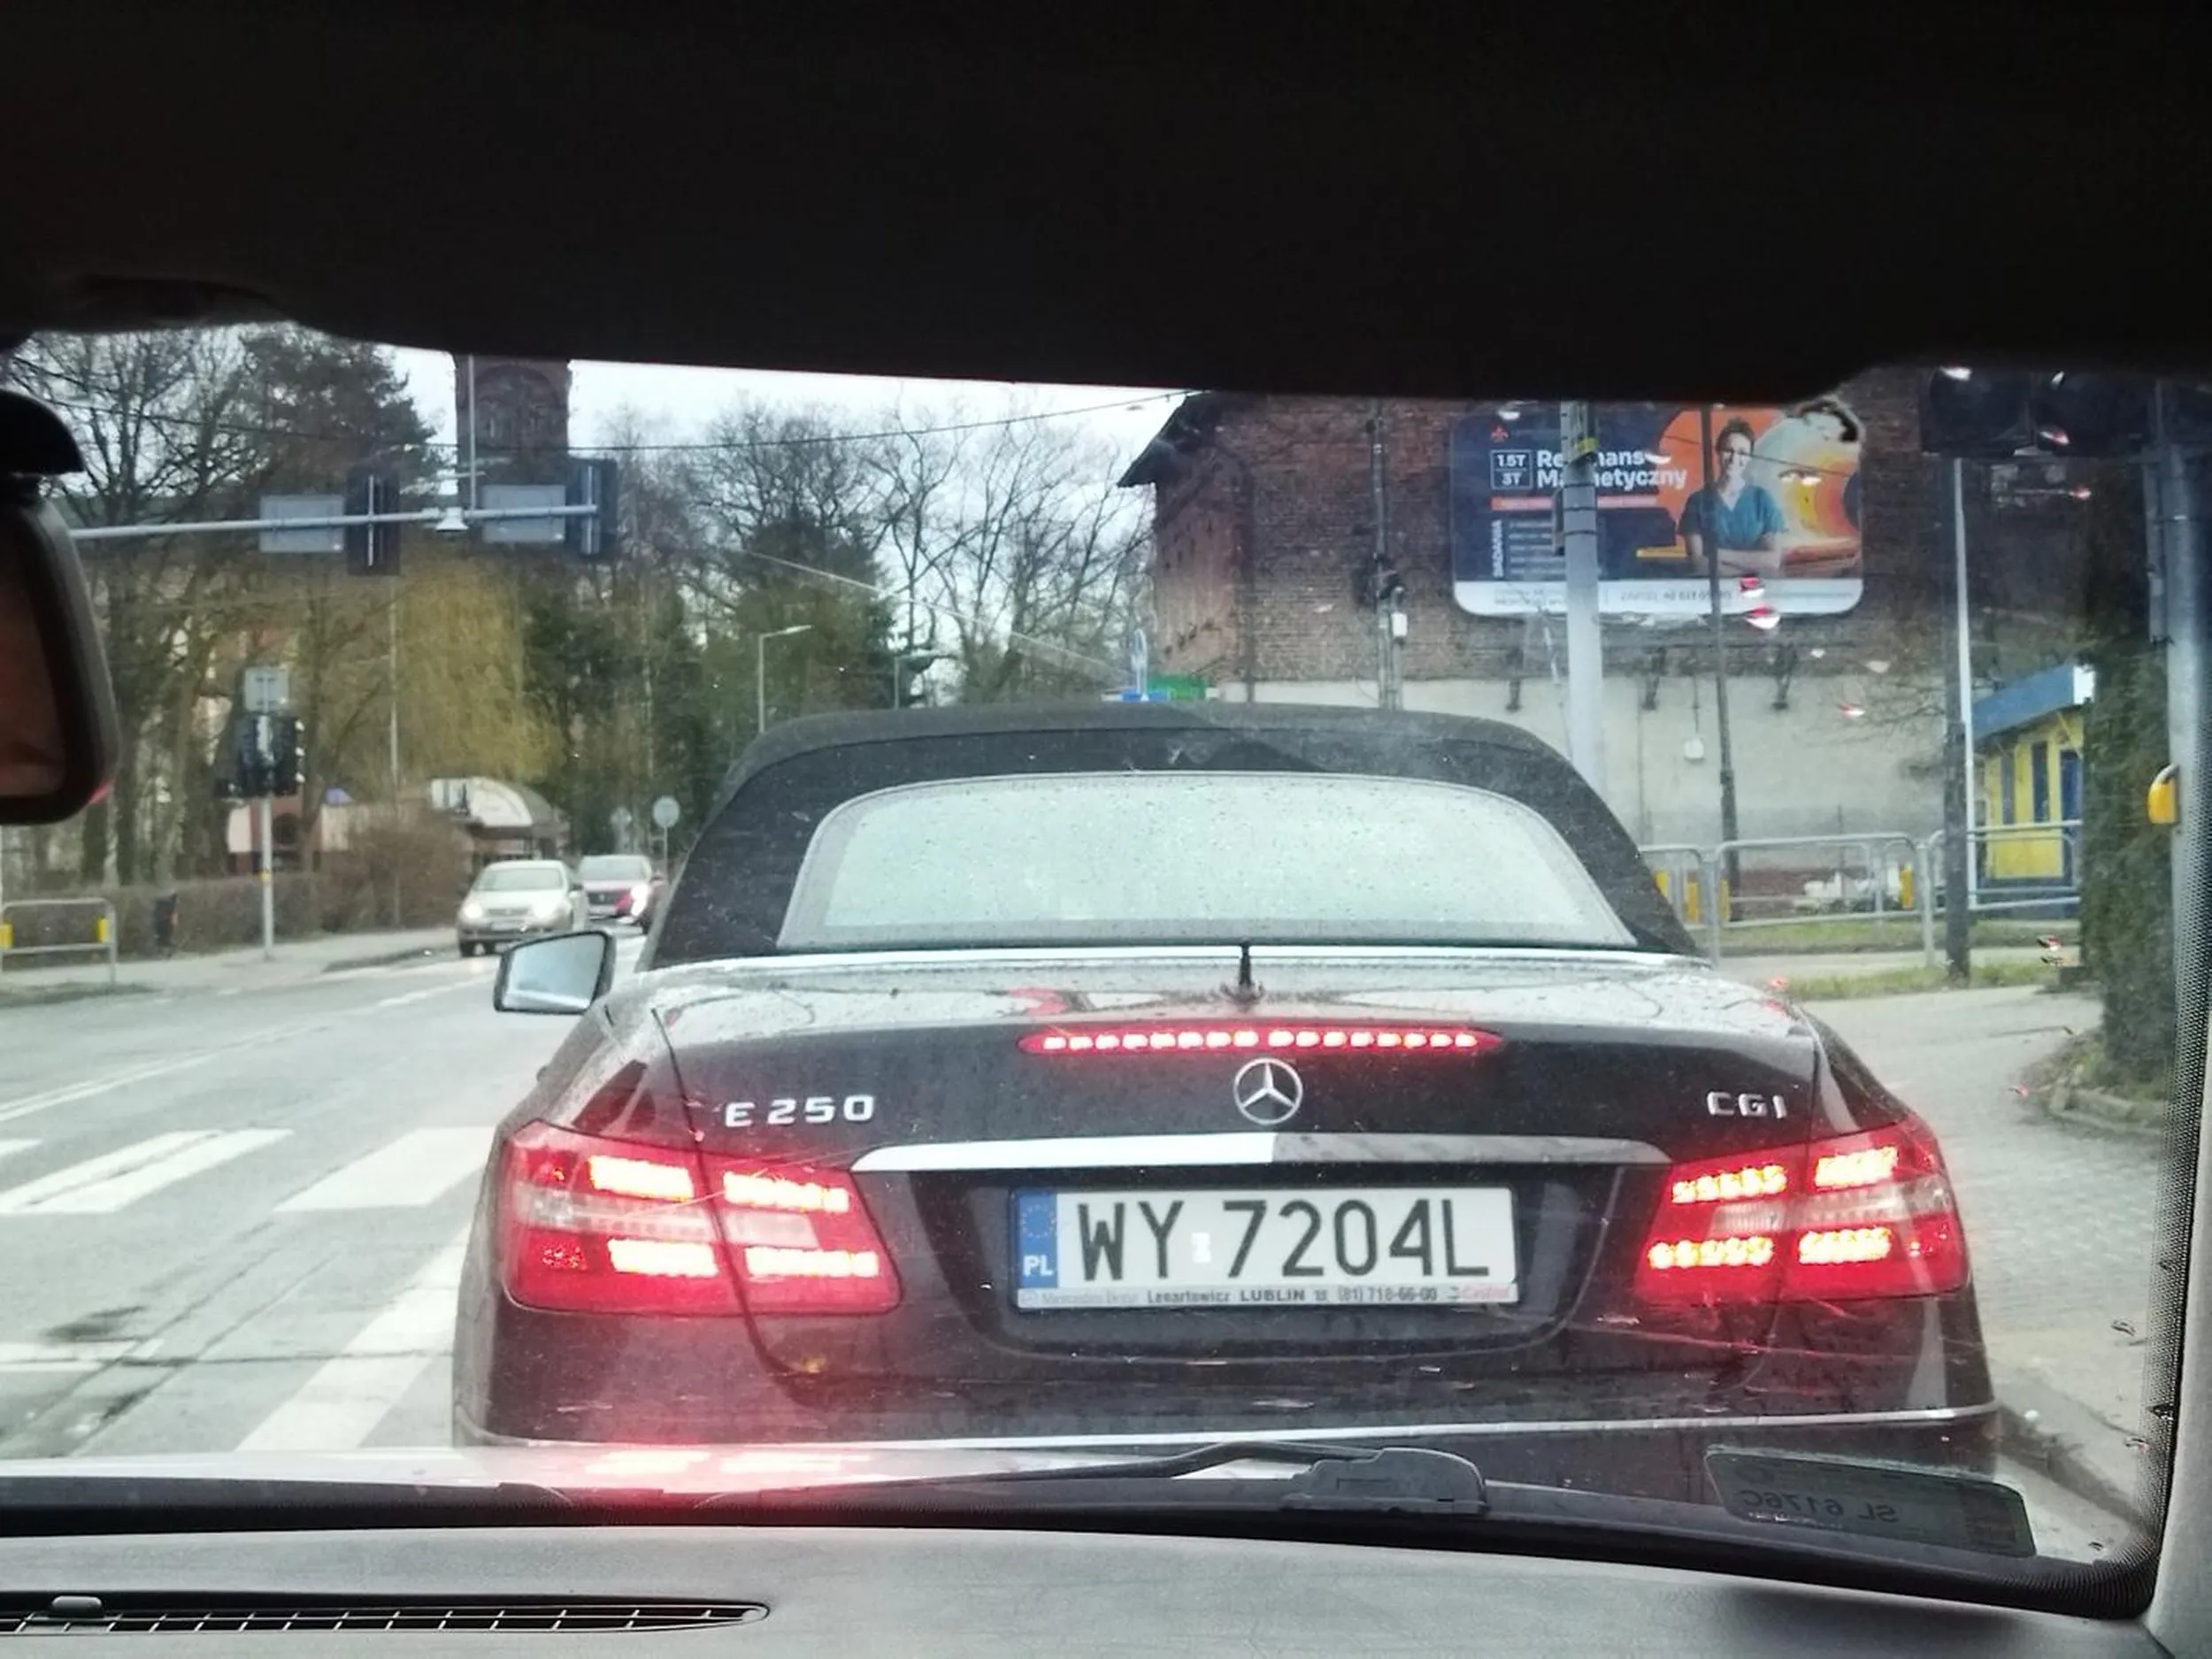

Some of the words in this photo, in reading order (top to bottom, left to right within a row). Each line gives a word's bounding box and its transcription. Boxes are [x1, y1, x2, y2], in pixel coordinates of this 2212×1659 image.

[1537, 468, 1687, 492] Mnetyczny
[725, 1102, 756, 1127] E
[767, 1094, 875, 1125] 250
[1707, 1091, 1787, 1119] CGI
[1078, 1200, 1184, 1280] WY
[1222, 1198, 1490, 1279] 7204L
[1023, 1255, 1054, 1277] PL
[1240, 1289, 1305, 1302] LUBLIN
